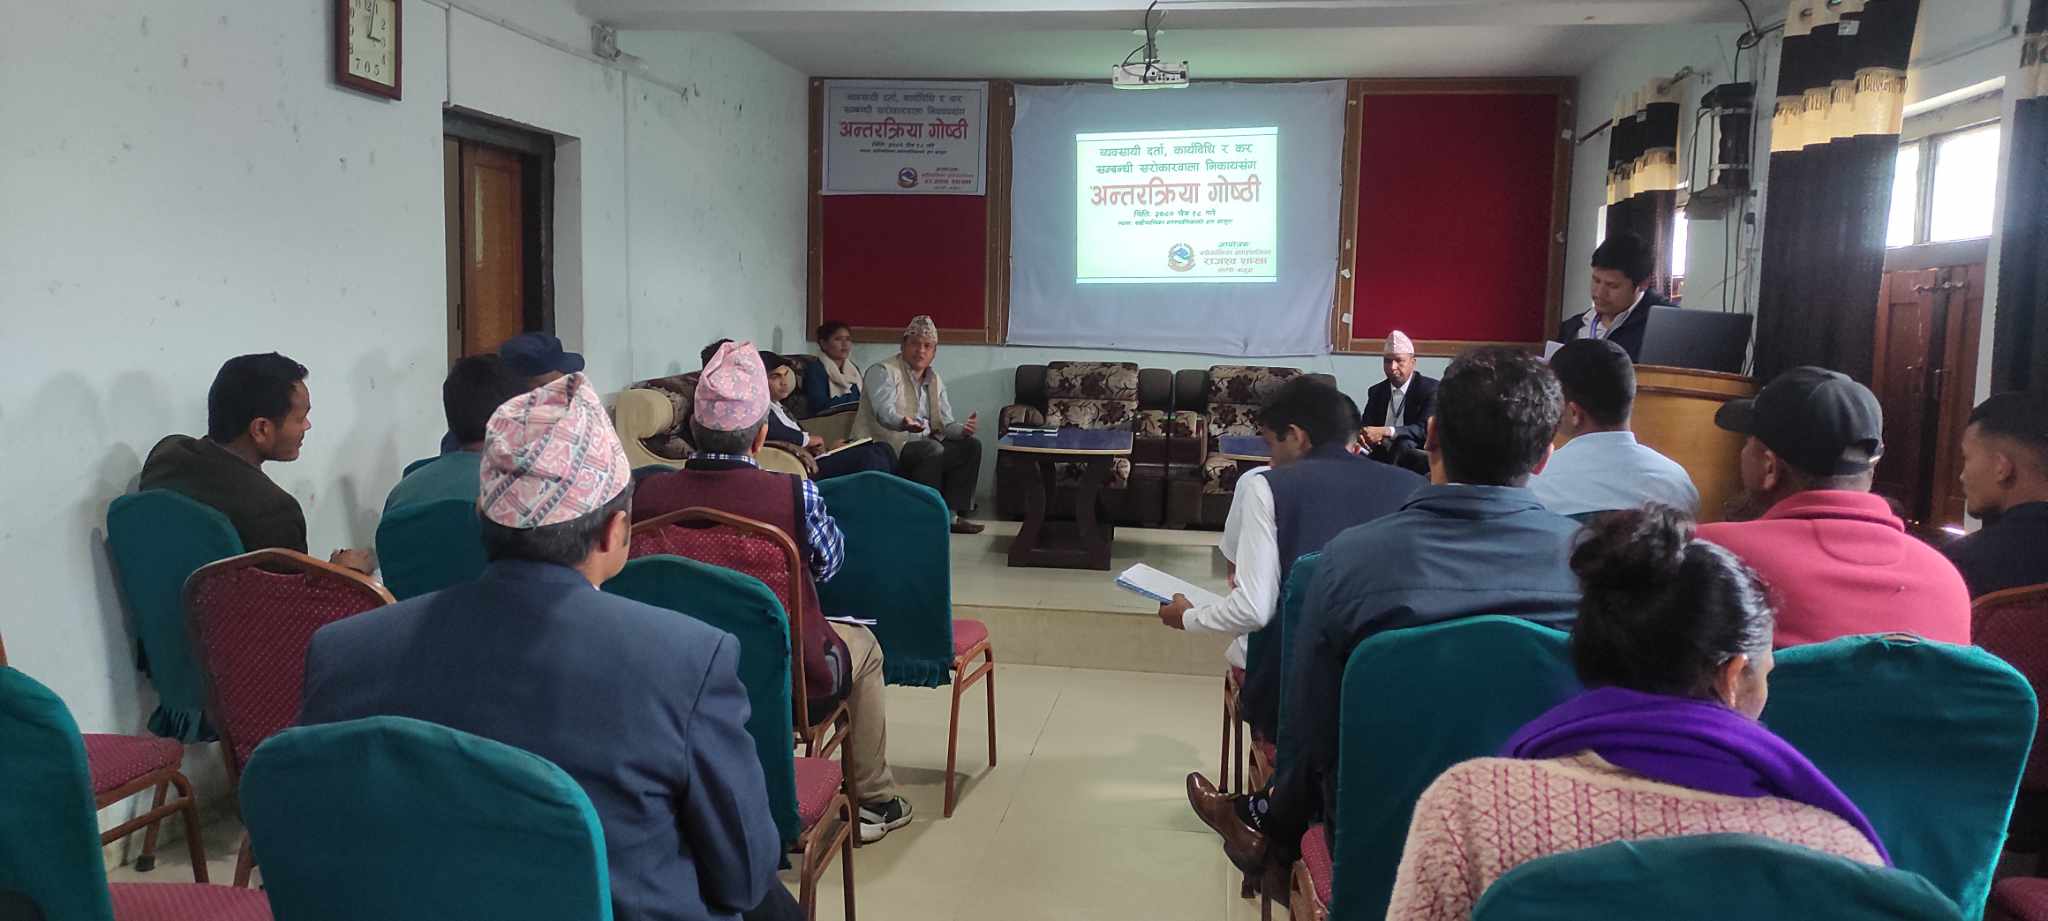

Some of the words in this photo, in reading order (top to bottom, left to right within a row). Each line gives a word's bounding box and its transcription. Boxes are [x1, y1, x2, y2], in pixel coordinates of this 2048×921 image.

[839, 117, 922, 140] अन्तरक्रिया
[928, 117, 968, 140] गोष्ठी
[1100, 144, 1141, 157] व्यवसायी
[1147, 143, 1168, 157] दर्ता,
[1174, 142, 1215, 154] कार्यविधि
[1221, 144, 1230, 154] र
[1235, 143, 1253, 153] कर
[1096, 161, 1133, 174] सम्बन्धी
[1139, 161, 1200, 173] सरोकारवाला
[1090, 176, 1200, 206] अन्तरक्रिया
[1208, 174, 1261, 204] गोष्ठी
